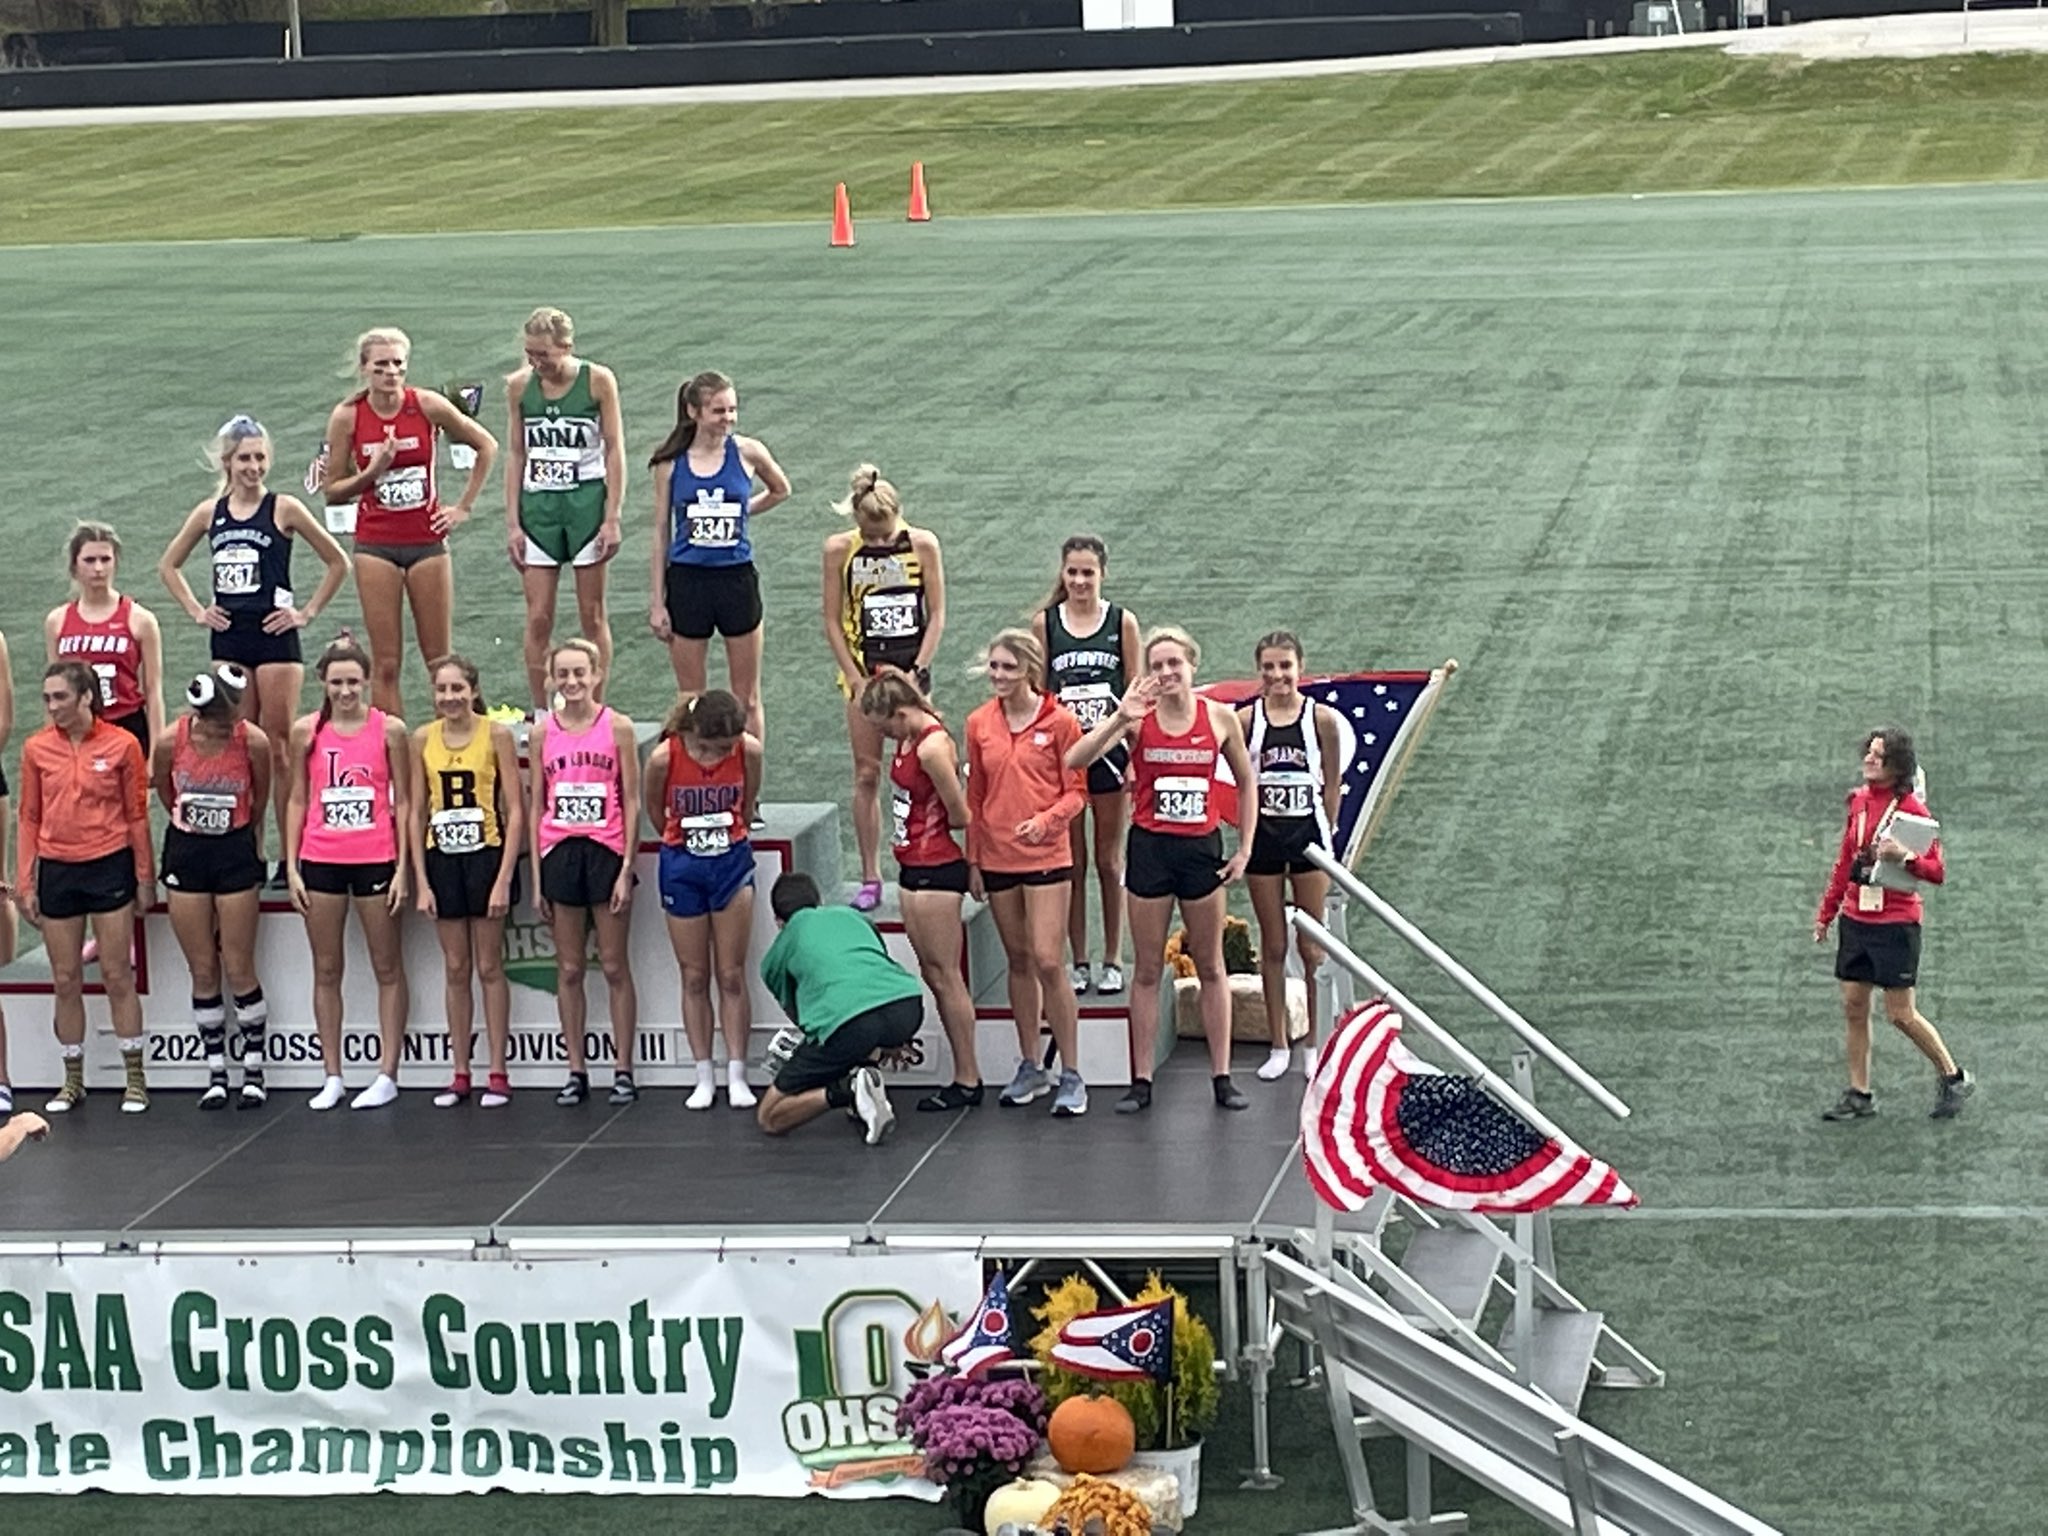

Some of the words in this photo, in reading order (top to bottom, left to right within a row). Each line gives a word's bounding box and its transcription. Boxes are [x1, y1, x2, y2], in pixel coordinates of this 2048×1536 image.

[528, 425, 588, 448] ANNA
[533, 461, 575, 481] 3325
[692, 517, 736, 540] 3347
[870, 607, 914, 629] 3354
[438, 769, 478, 809] B
[186, 805, 231, 828] 3208
[326, 801, 371, 824] 3252
[557, 796, 602, 820] 3353
[150, 1033, 209, 1061] 202
[228, 1033, 325, 1061] COSS
[640, 1032, 666, 1061] III
[170, 1289, 395, 1392] Cross
[421, 1292, 744, 1419] Country
[141, 1412, 738, 1489] Championship
